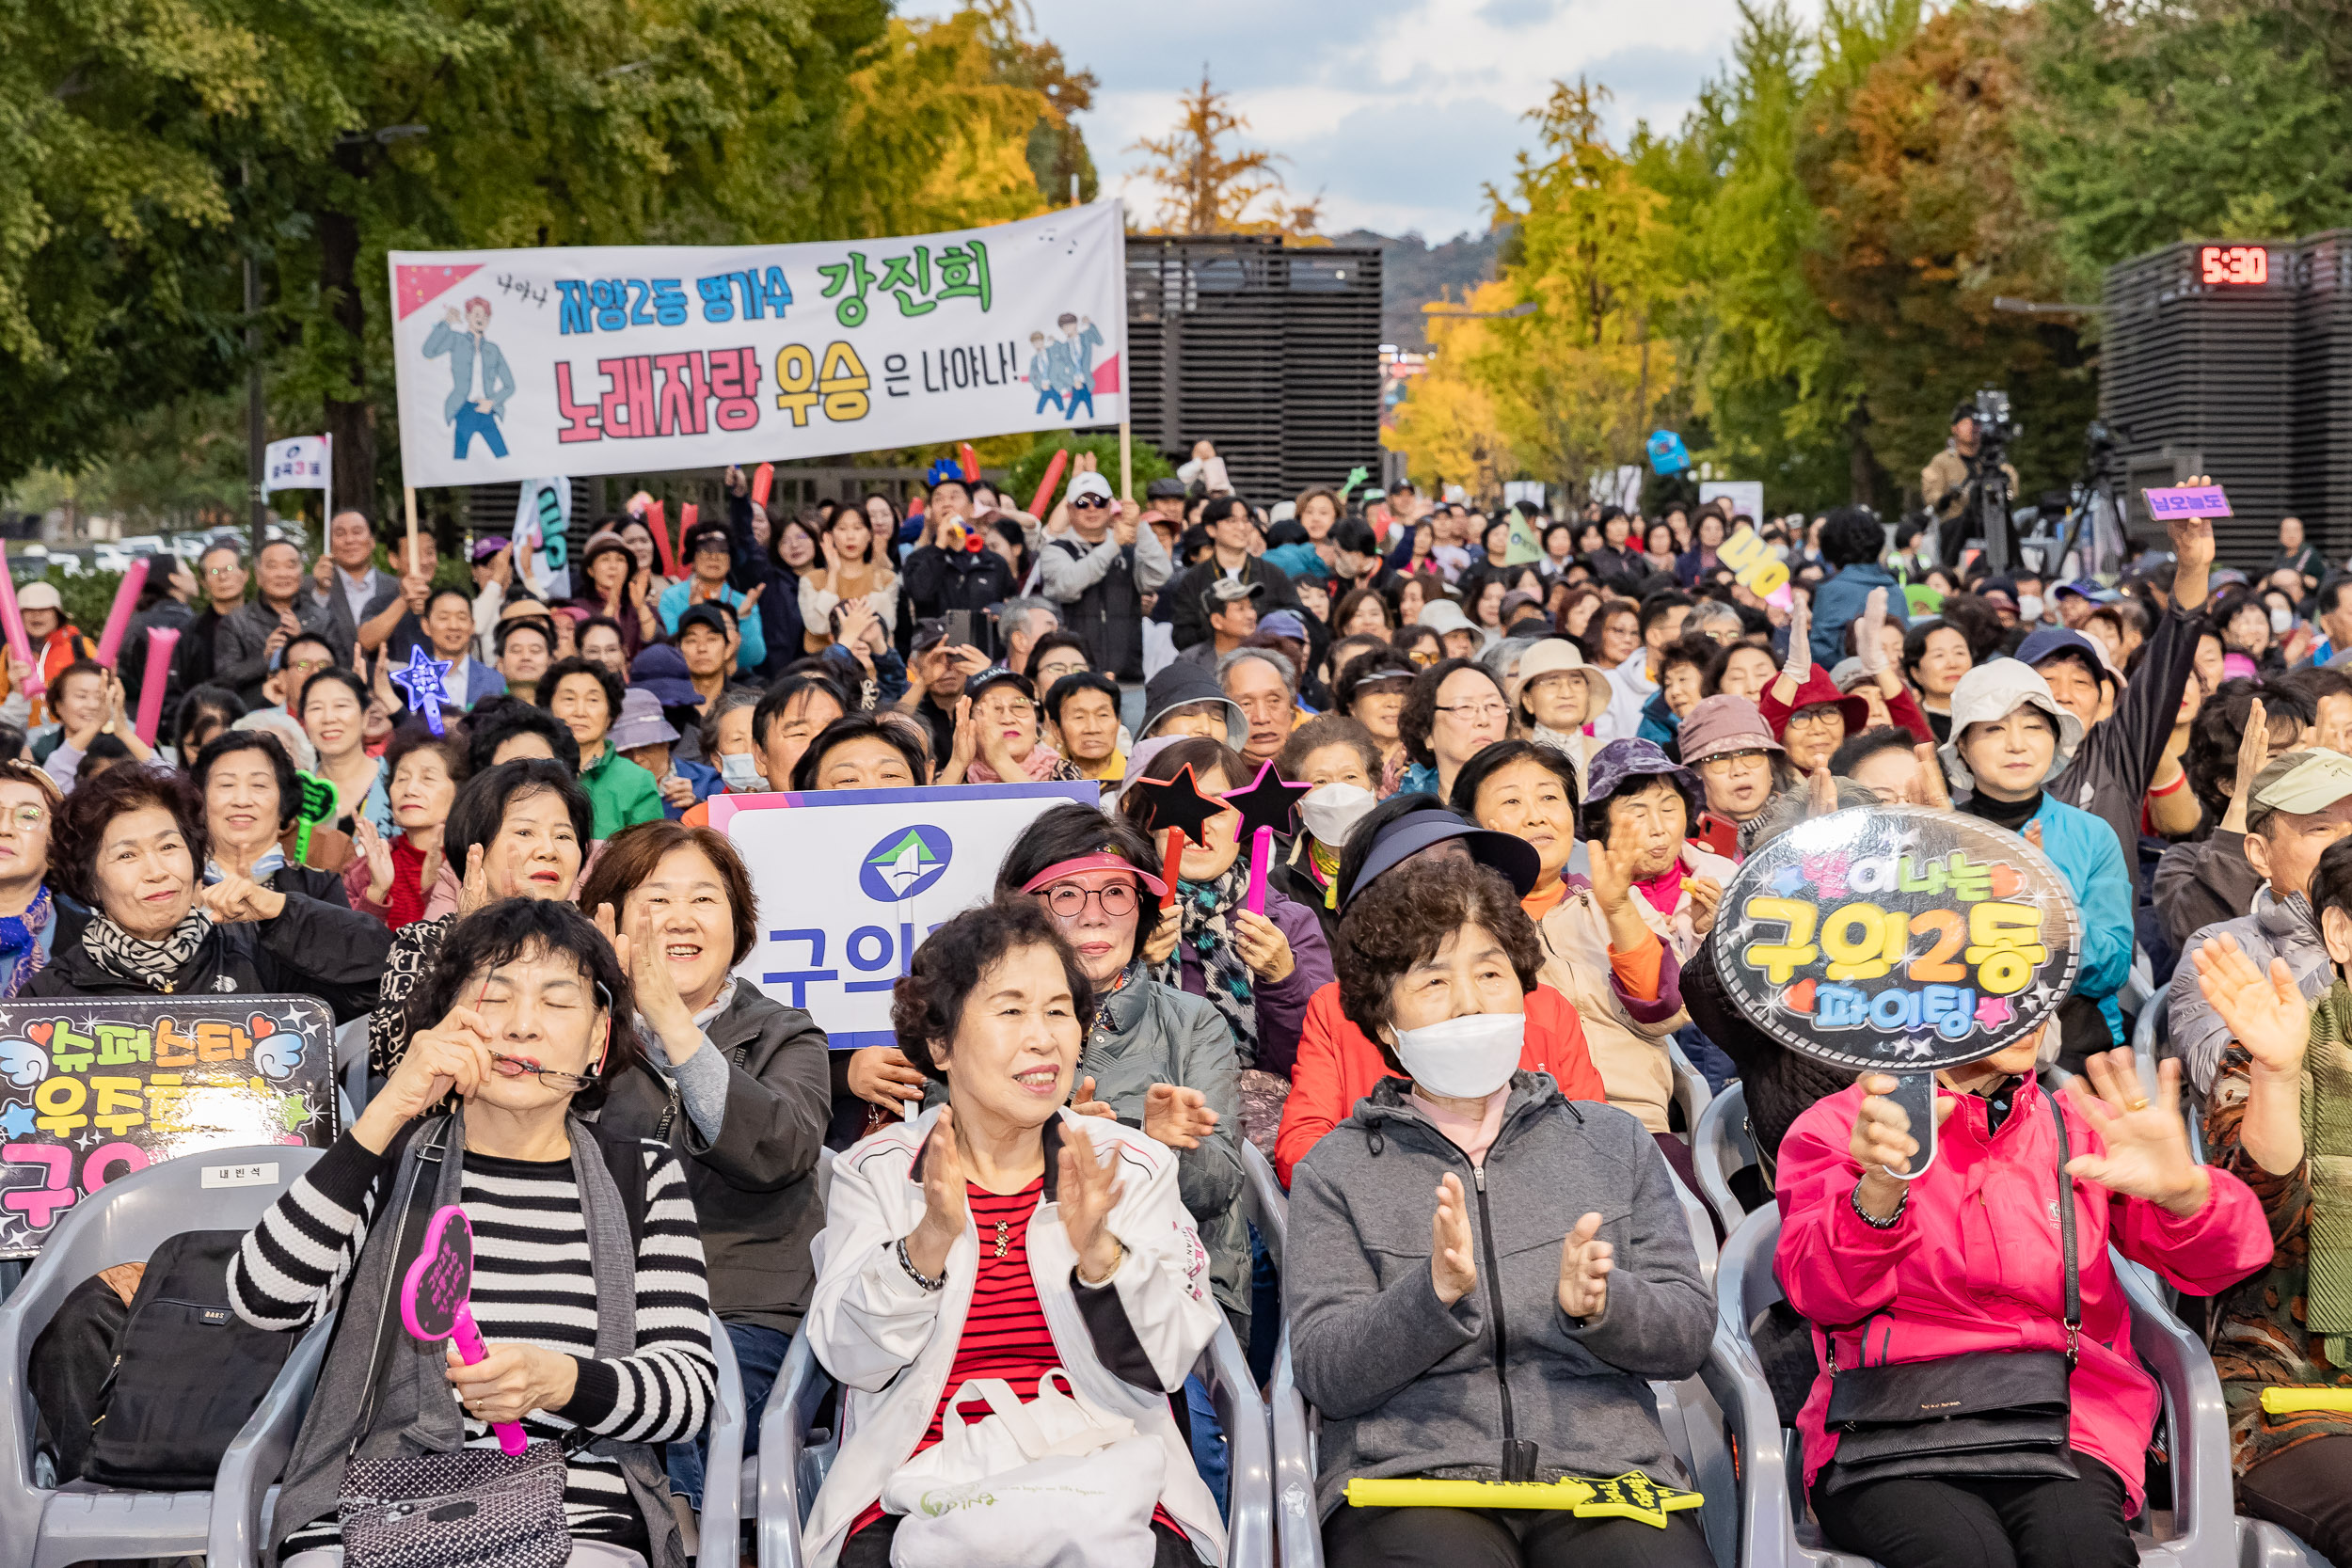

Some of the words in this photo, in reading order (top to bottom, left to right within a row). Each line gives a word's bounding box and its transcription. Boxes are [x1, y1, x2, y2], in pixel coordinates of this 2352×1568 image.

[555, 278, 688, 335] 자양2동
[696, 265, 793, 323] 명가수
[818, 240, 992, 327] 강진희
[2202, 246, 2267, 284] 5:30
[554, 346, 762, 445] 노래자랑
[775, 340, 871, 428] 우승
[884, 354, 911, 398] 은
[763, 921, 946, 1008] 구의
[1746, 896, 2047, 994] 구의2동
[52, 1021, 253, 1073] 슈퍼스타
[1815, 982, 1977, 1037] 파이팅
